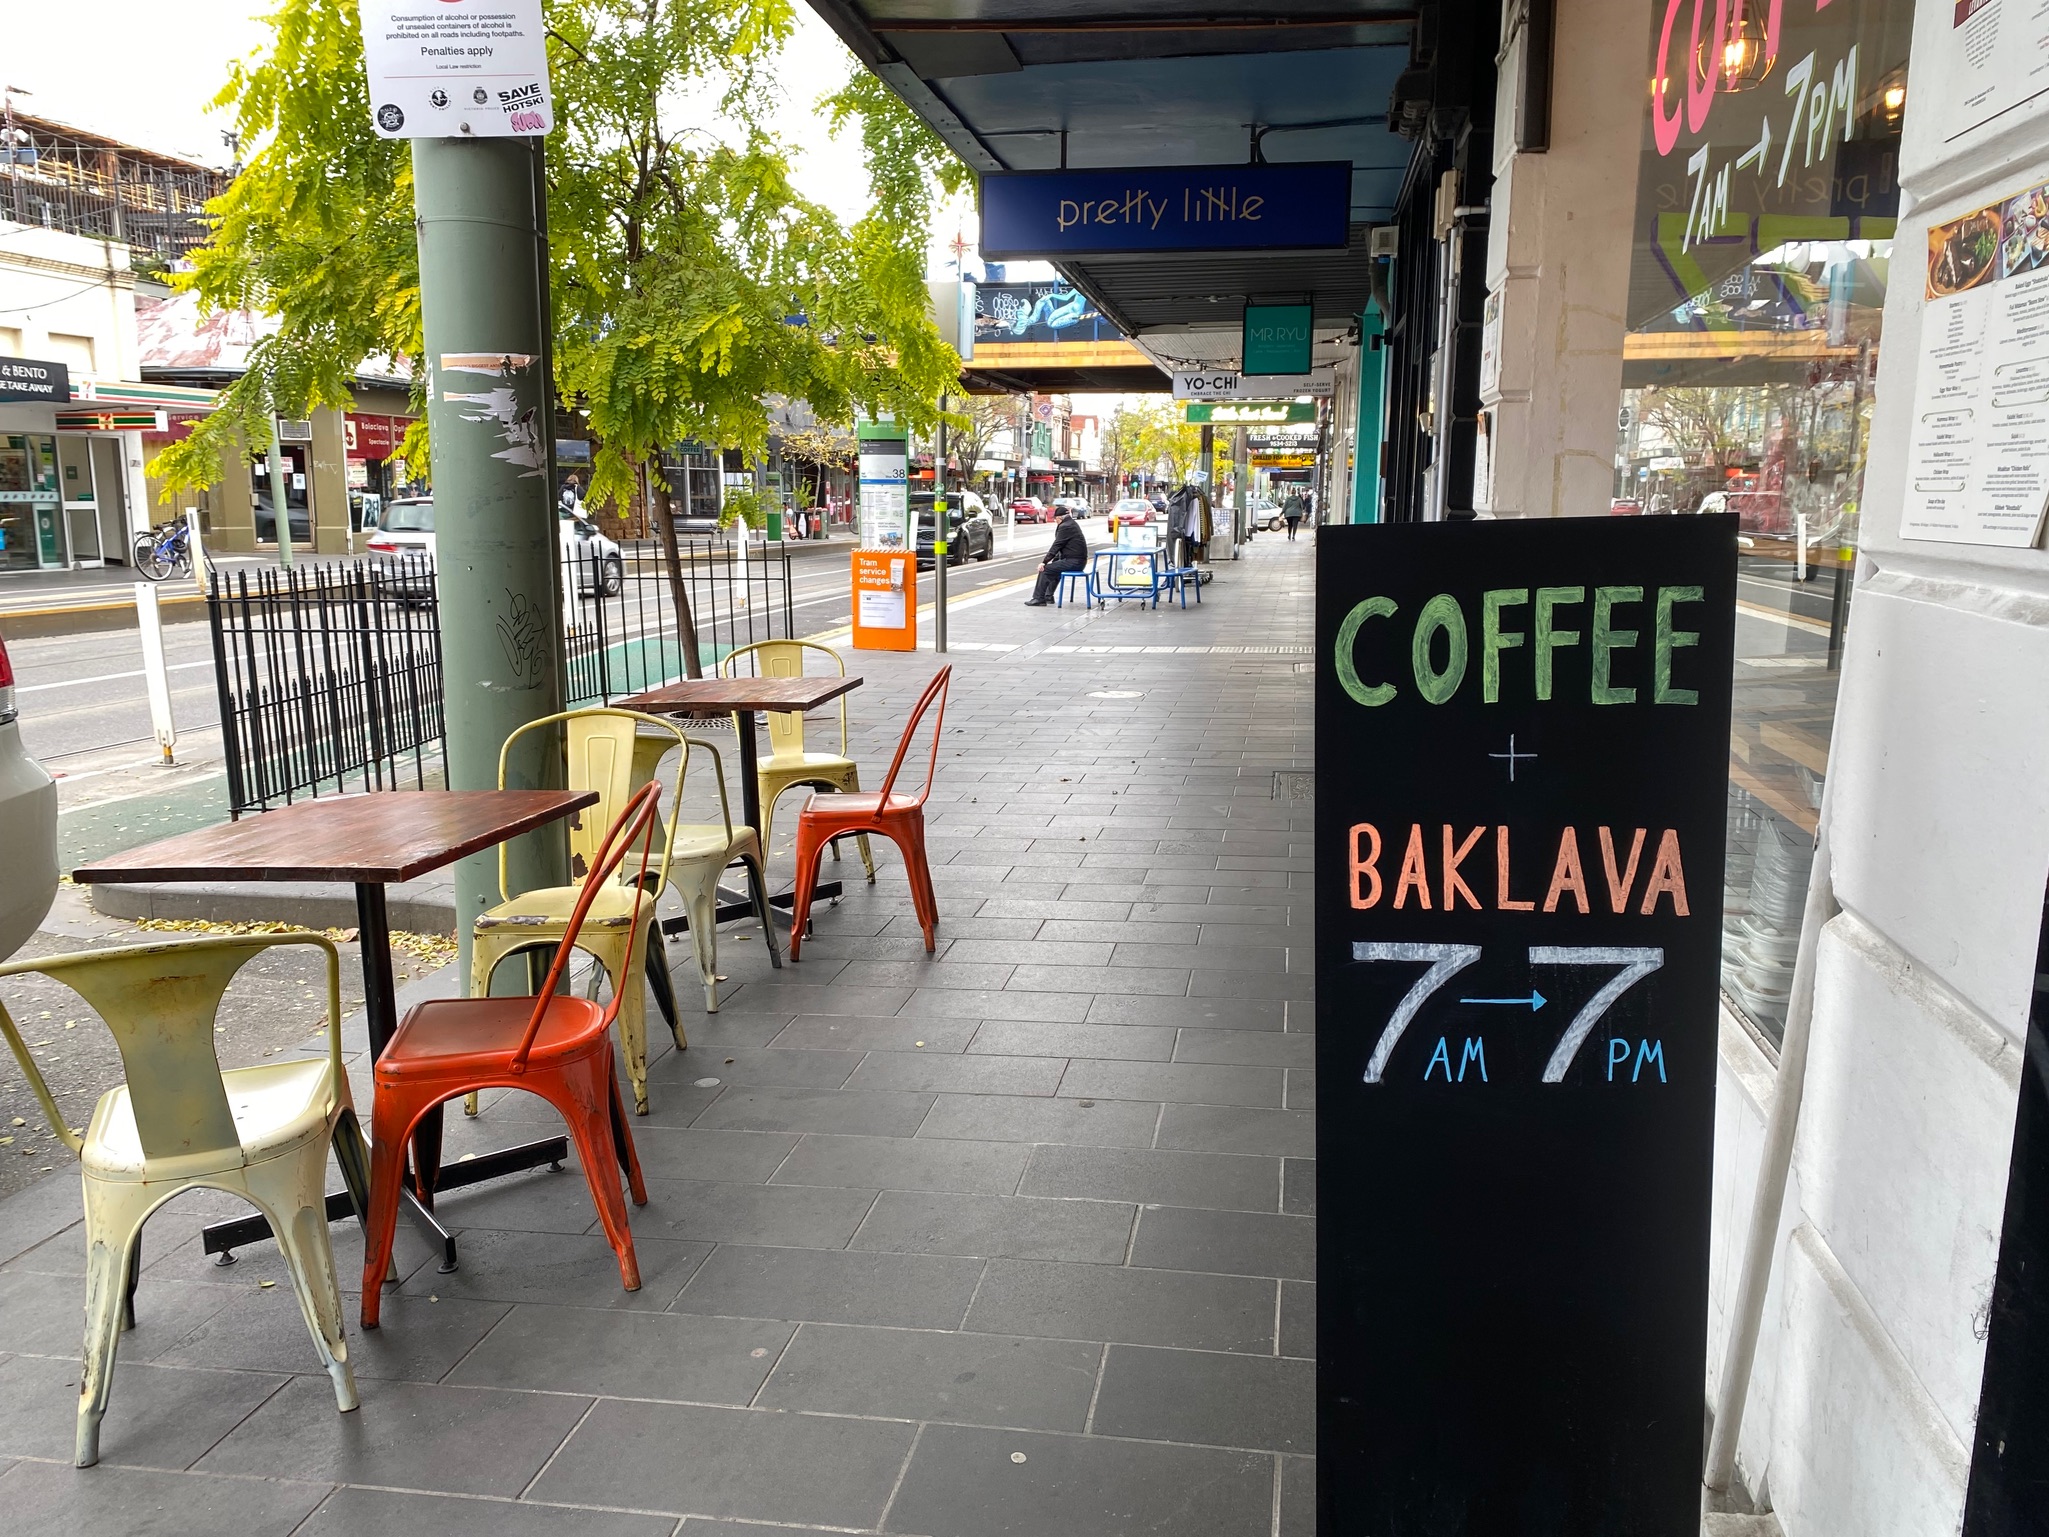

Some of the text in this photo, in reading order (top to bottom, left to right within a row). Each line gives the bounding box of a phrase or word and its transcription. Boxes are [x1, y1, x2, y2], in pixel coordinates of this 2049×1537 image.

[391, 14, 436, 22] Consumption
[479, 13, 516, 21] possession
[386, 32, 419, 40] prohibited
[460, 30, 491, 39] including
[491, 30, 525, 39] footpaths.
[421, 46, 494, 57] Penalties apply
[499, 83, 541, 102] SAVE
[503, 96, 544, 114] HOTSKI
[1057, 186, 1264, 232] pretty little
[1251, 327, 1307, 341] MR RYU
[1, 365, 48, 380] & BENTO
[7, 381, 29, 391] TAKE
[29, 383, 54, 393] AWAY
[1184, 377, 1237, 390] YO-CHI
[361, 422, 389, 431] Balaclava
[892, 469, 905, 478] 38
[859, 558, 878, 566] Tram
[859, 576, 890, 586] changes
[1334, 586, 1704, 707] COFFEE
[1349, 823, 1690, 916] BAKLAVA
